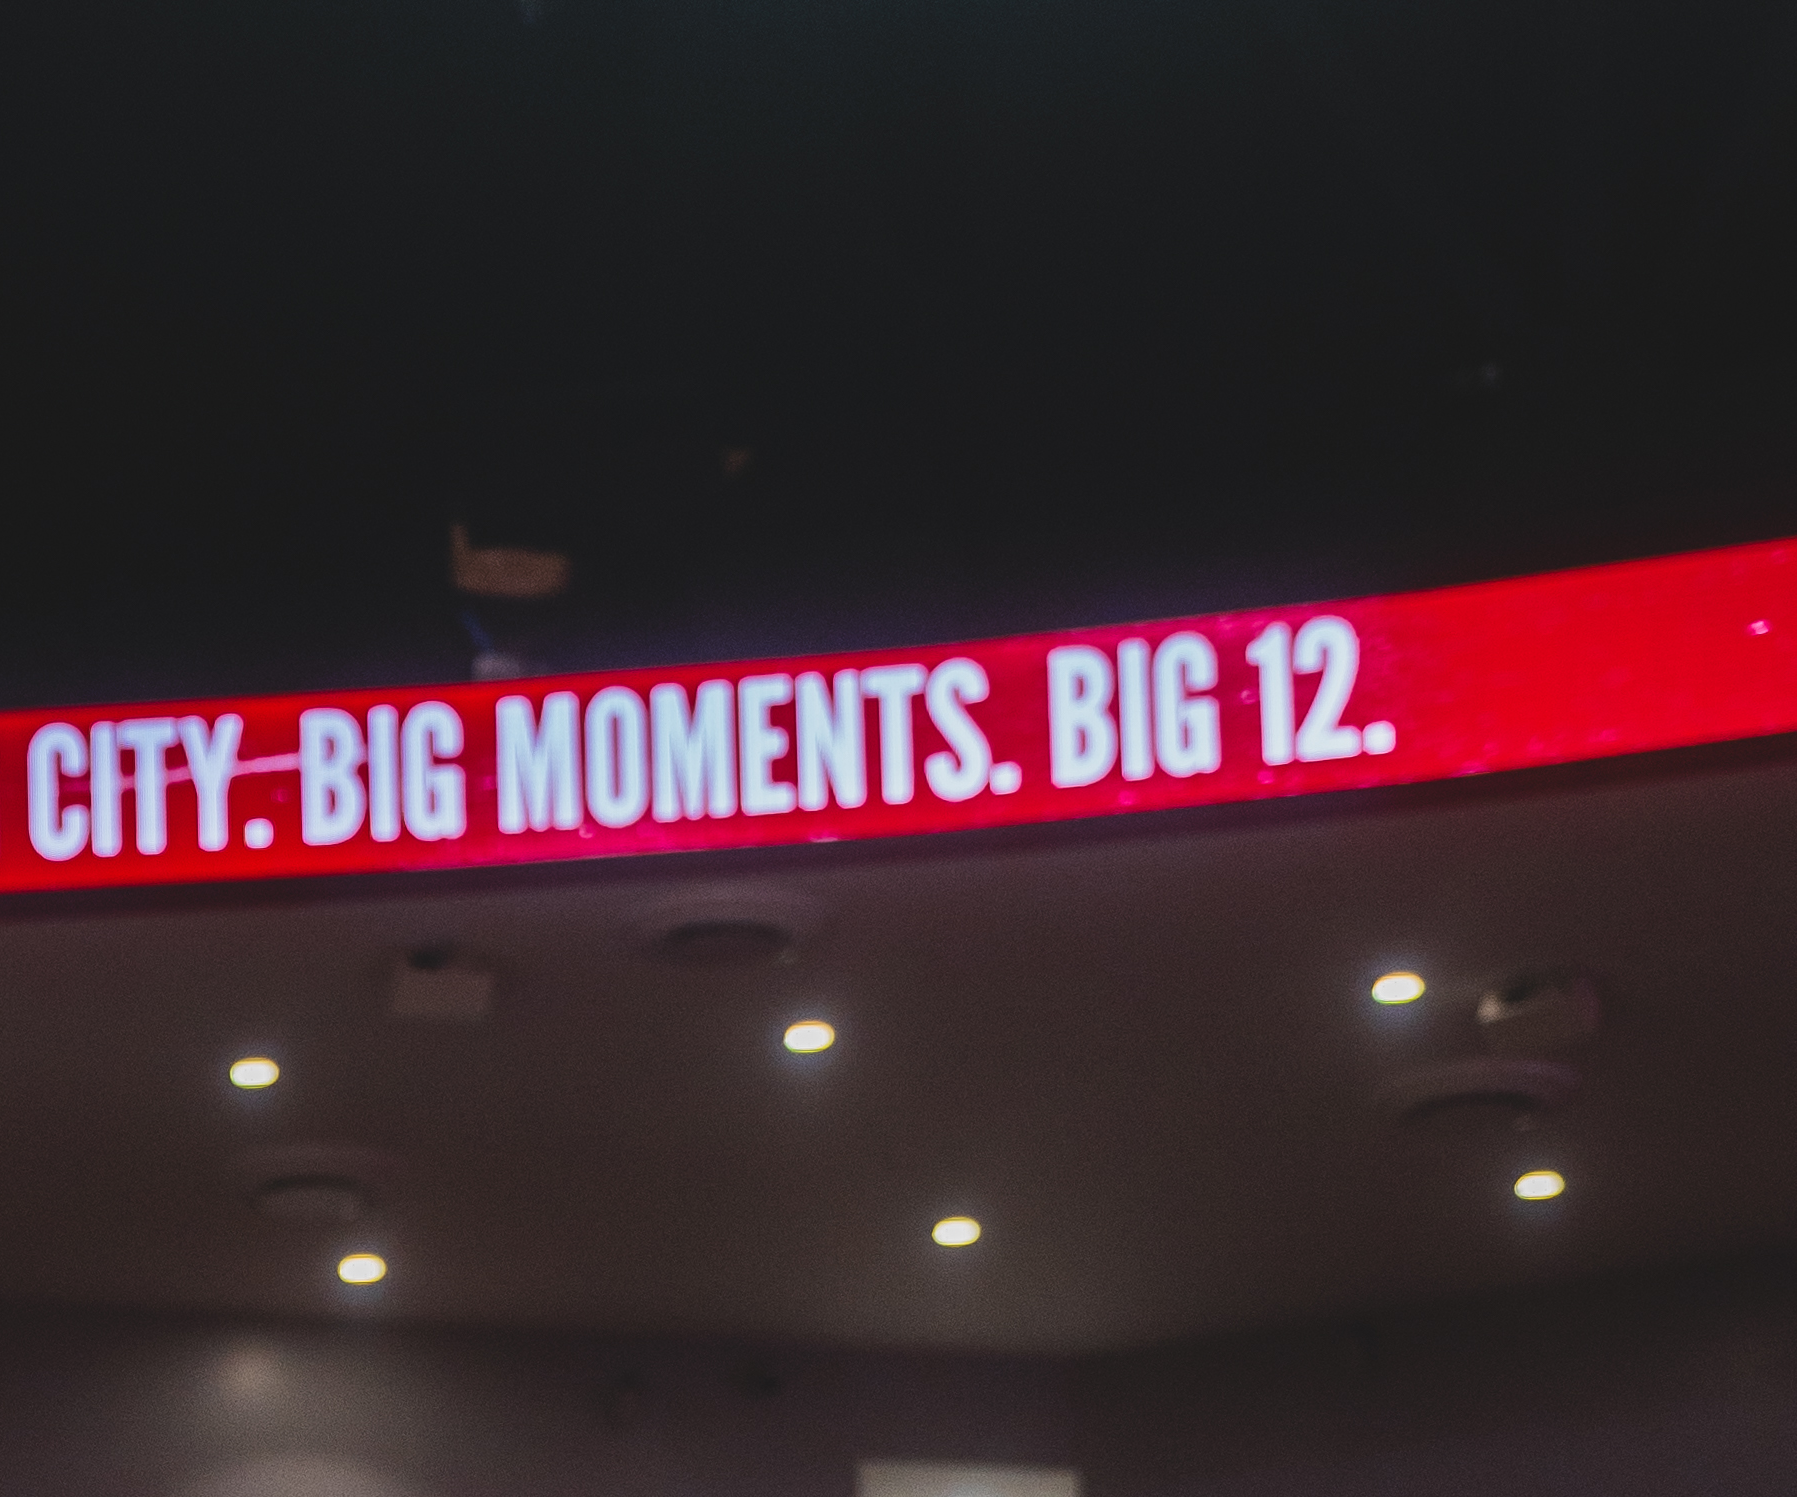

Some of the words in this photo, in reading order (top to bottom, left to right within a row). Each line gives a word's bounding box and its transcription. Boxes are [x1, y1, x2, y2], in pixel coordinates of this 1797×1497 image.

[27, 713, 273, 861] CITY.
[299, 701, 466, 846] BIG
[495, 657, 1022, 834] MOMENTS.
[1047, 631, 1221, 788] BIG
[1245, 615, 1396, 766] 12.
